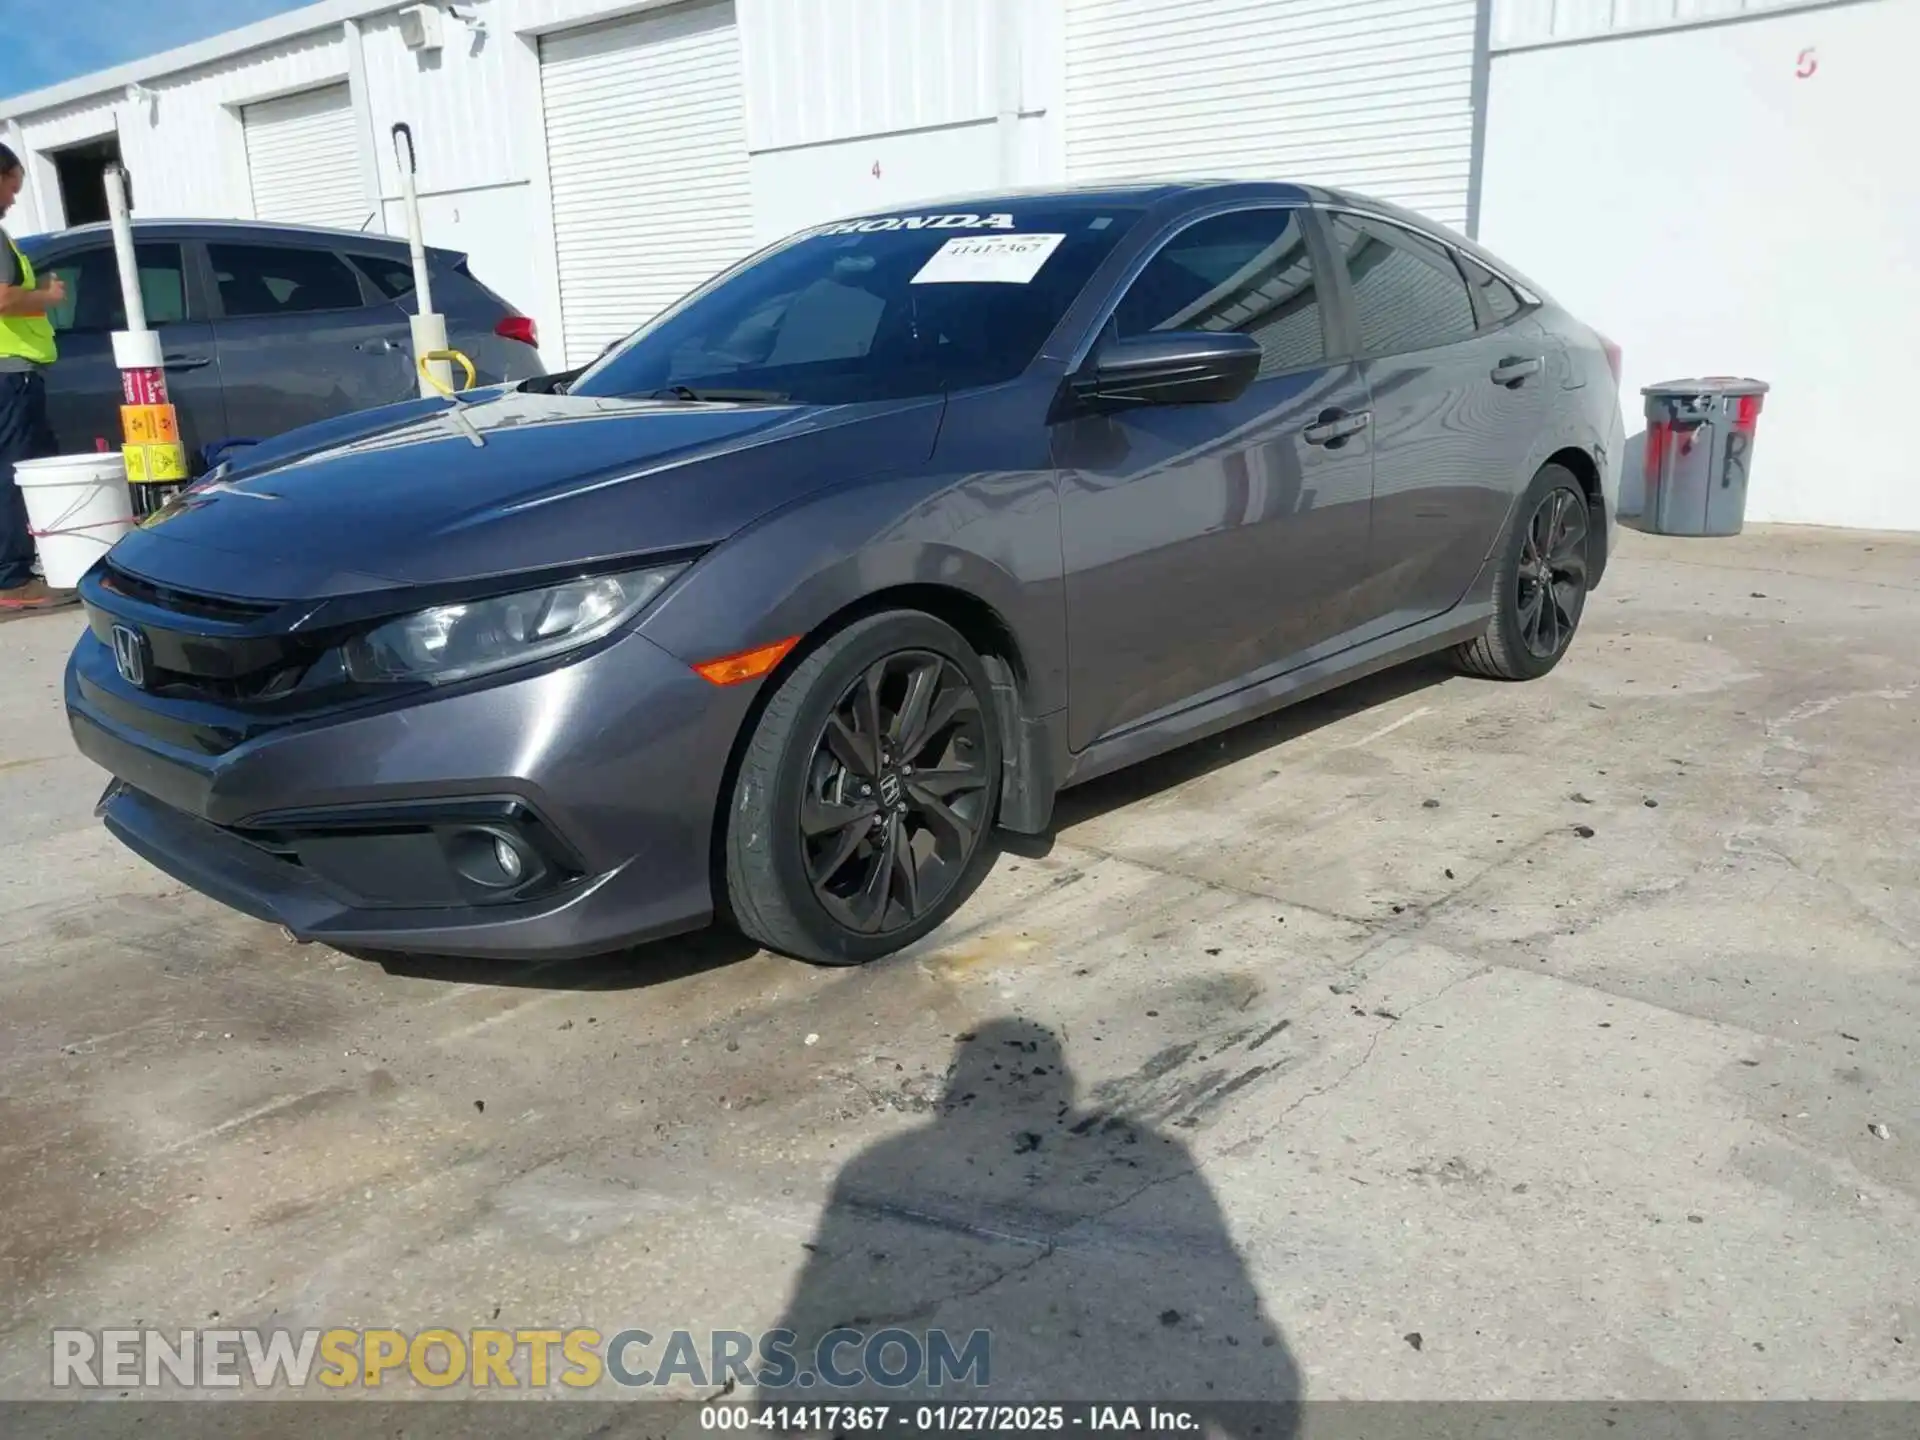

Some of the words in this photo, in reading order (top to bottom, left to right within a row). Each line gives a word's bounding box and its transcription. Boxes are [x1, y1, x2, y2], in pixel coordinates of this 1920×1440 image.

[1796, 47, 1817, 79] 5
[872, 160, 880, 180] 4
[818, 213, 1016, 236] HONDA
